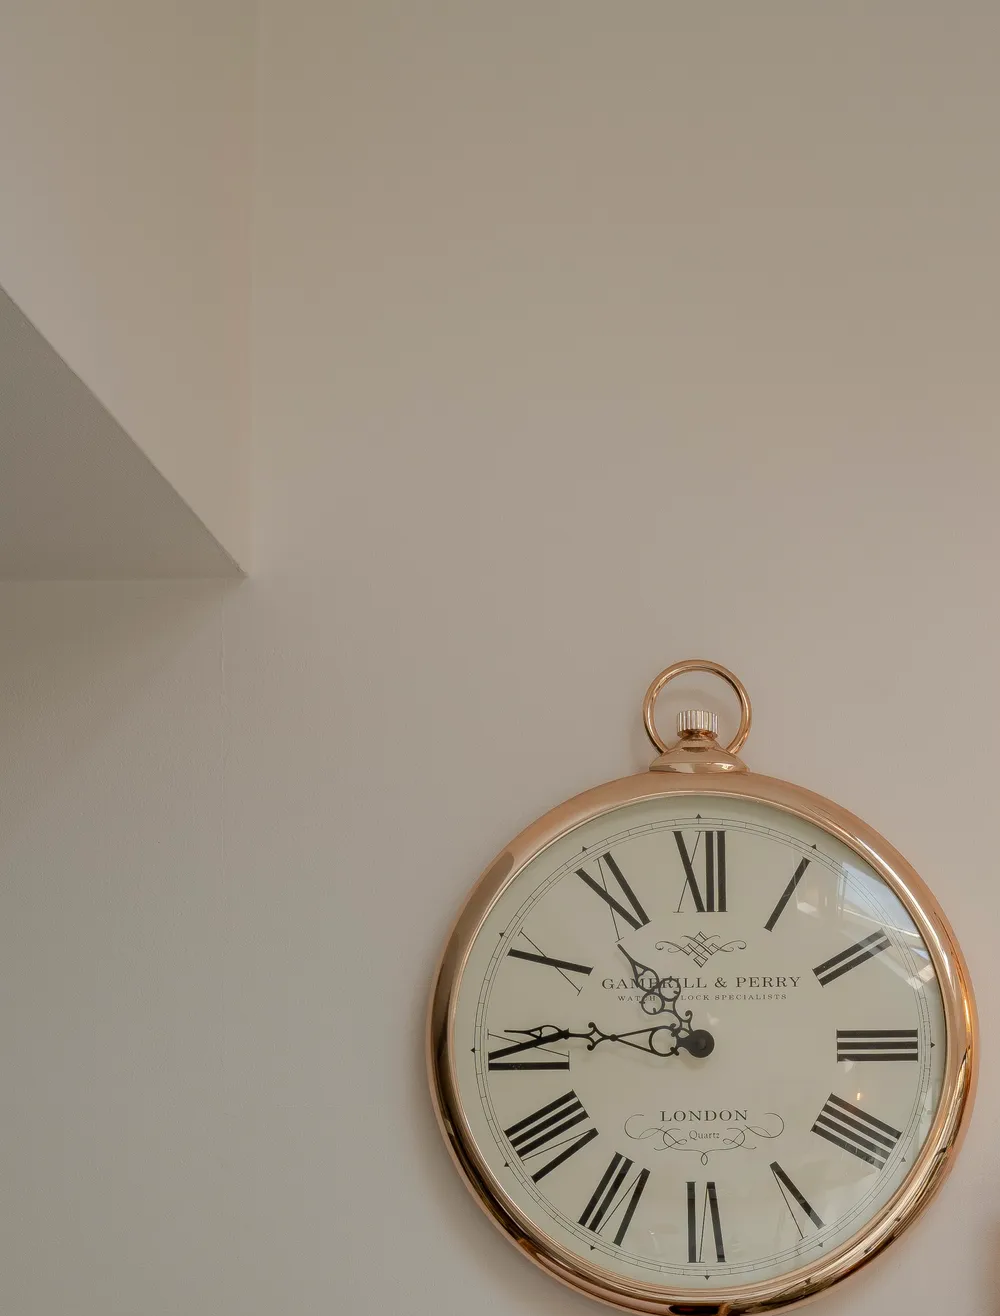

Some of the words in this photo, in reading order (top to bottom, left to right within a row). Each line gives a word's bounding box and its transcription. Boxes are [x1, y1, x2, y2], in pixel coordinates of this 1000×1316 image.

[672, 830, 727, 912] XII
[506, 927, 594, 996] X
[714, 976, 728, 988] &
[735, 976, 801, 988] PERRY
[714, 993, 788, 1001] SPECIALISTS
[659, 1109, 748, 1122] LONDON
[688, 1129, 720, 1141] Quartz
